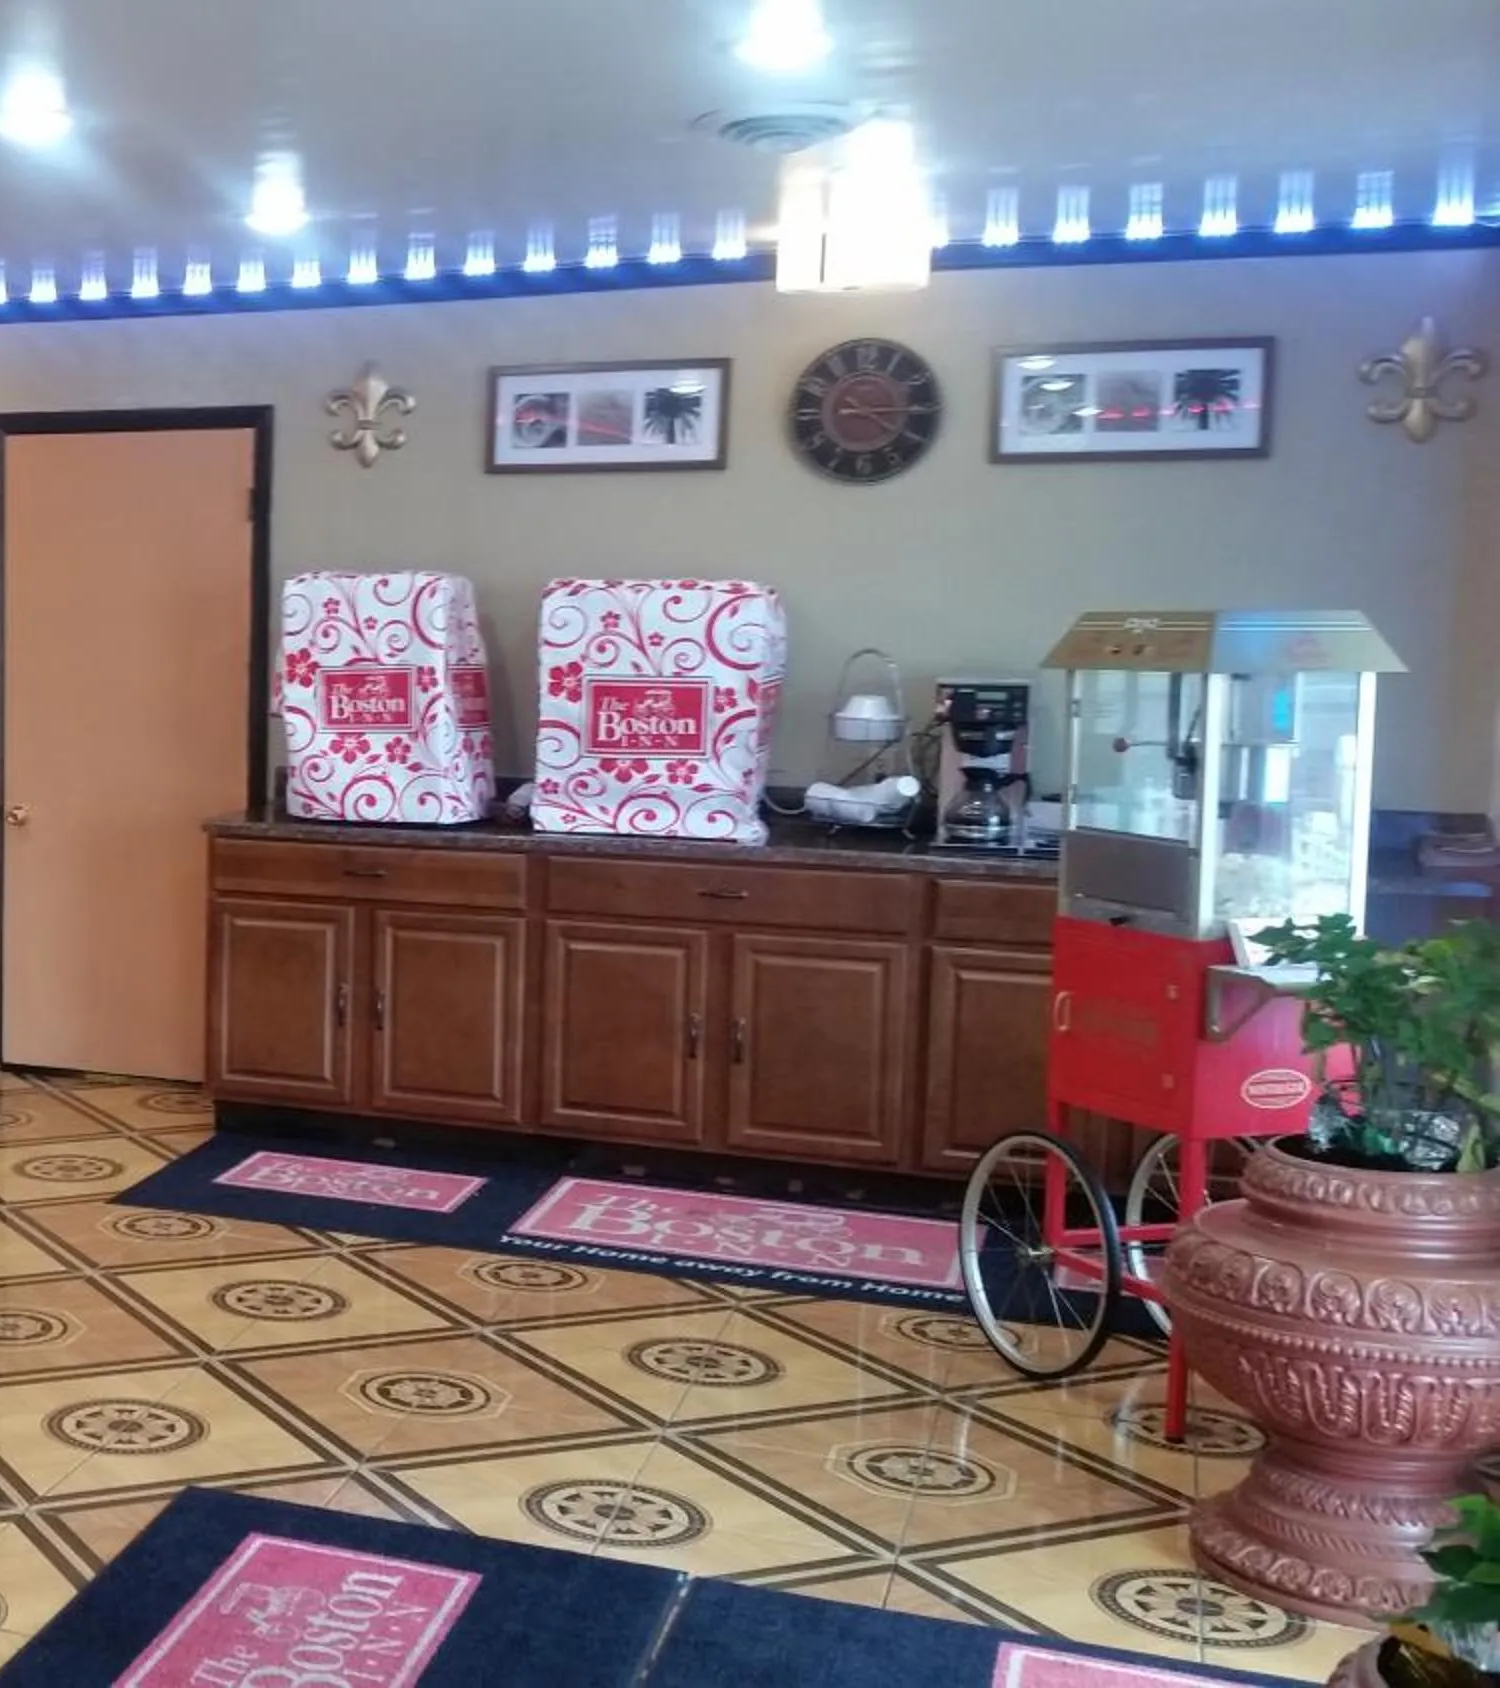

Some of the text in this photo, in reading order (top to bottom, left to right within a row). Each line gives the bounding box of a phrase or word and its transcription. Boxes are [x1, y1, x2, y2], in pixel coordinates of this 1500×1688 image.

[331, 695, 406, 719] Boston
[597, 711, 697, 741] Boston
[564, 1202, 926, 1267] Boston
[500, 1233, 967, 1302] Your Home away from Home
[190, 1643, 260, 1688] The
